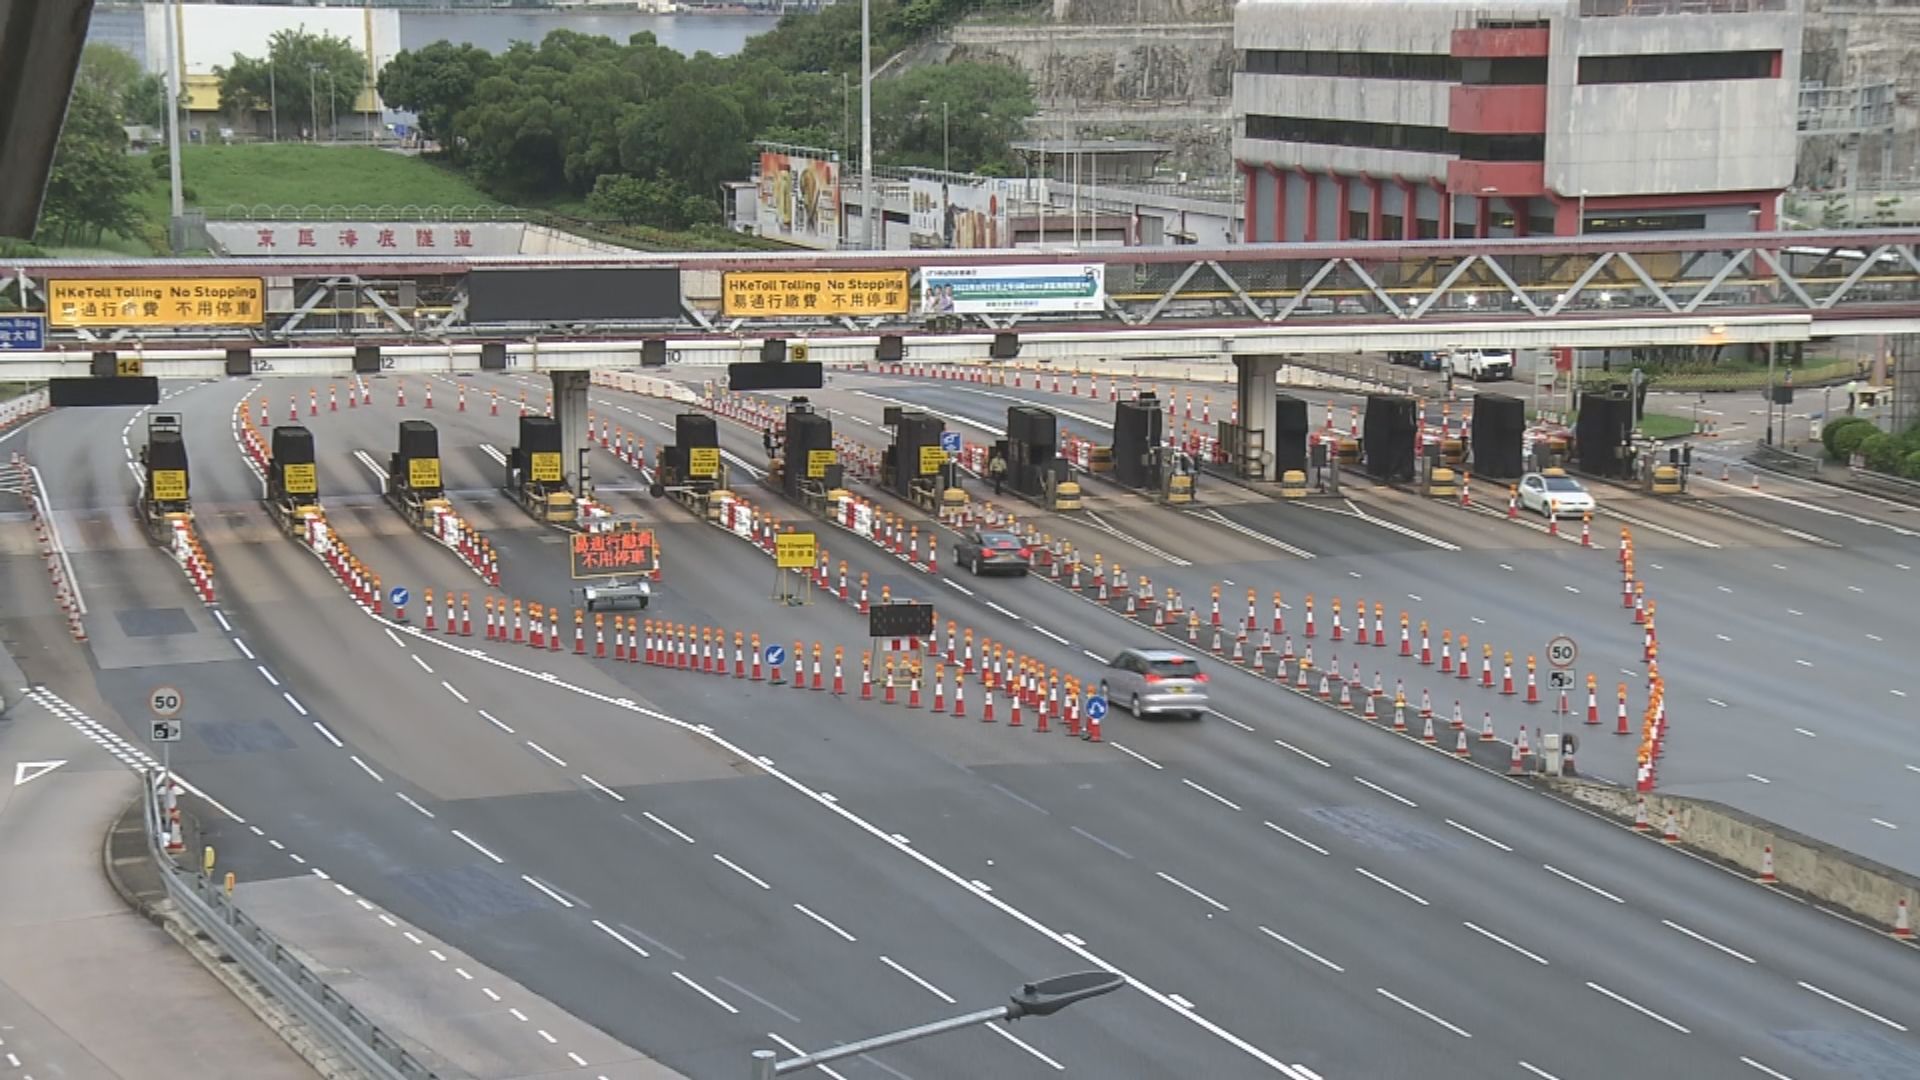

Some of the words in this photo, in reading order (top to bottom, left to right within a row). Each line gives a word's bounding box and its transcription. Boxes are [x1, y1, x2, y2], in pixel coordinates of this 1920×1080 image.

[257, 229, 473, 247] 東區海底隧道
[55, 286, 111, 298] HKeToll
[114, 286, 162, 299] Tolling
[169, 286, 191, 297] No
[194, 285, 257, 299] Stopping
[729, 280, 776, 291] HKeToll
[780, 280, 821, 292] Tolling
[827, 280, 845, 290] No
[848, 278, 903, 291] Stopping
[832, 292, 898, 307] 不用停車
[175, 301, 252, 317] 不用停車
[667, 350, 682, 363] 10
[794, 347, 805, 360] 9
[118, 361, 140, 374] 14
[381, 357, 395, 370] 12
[582, 549, 645, 569] 不用停車
[1552, 646, 1573, 659] 50
[155, 695, 177, 709] 50
